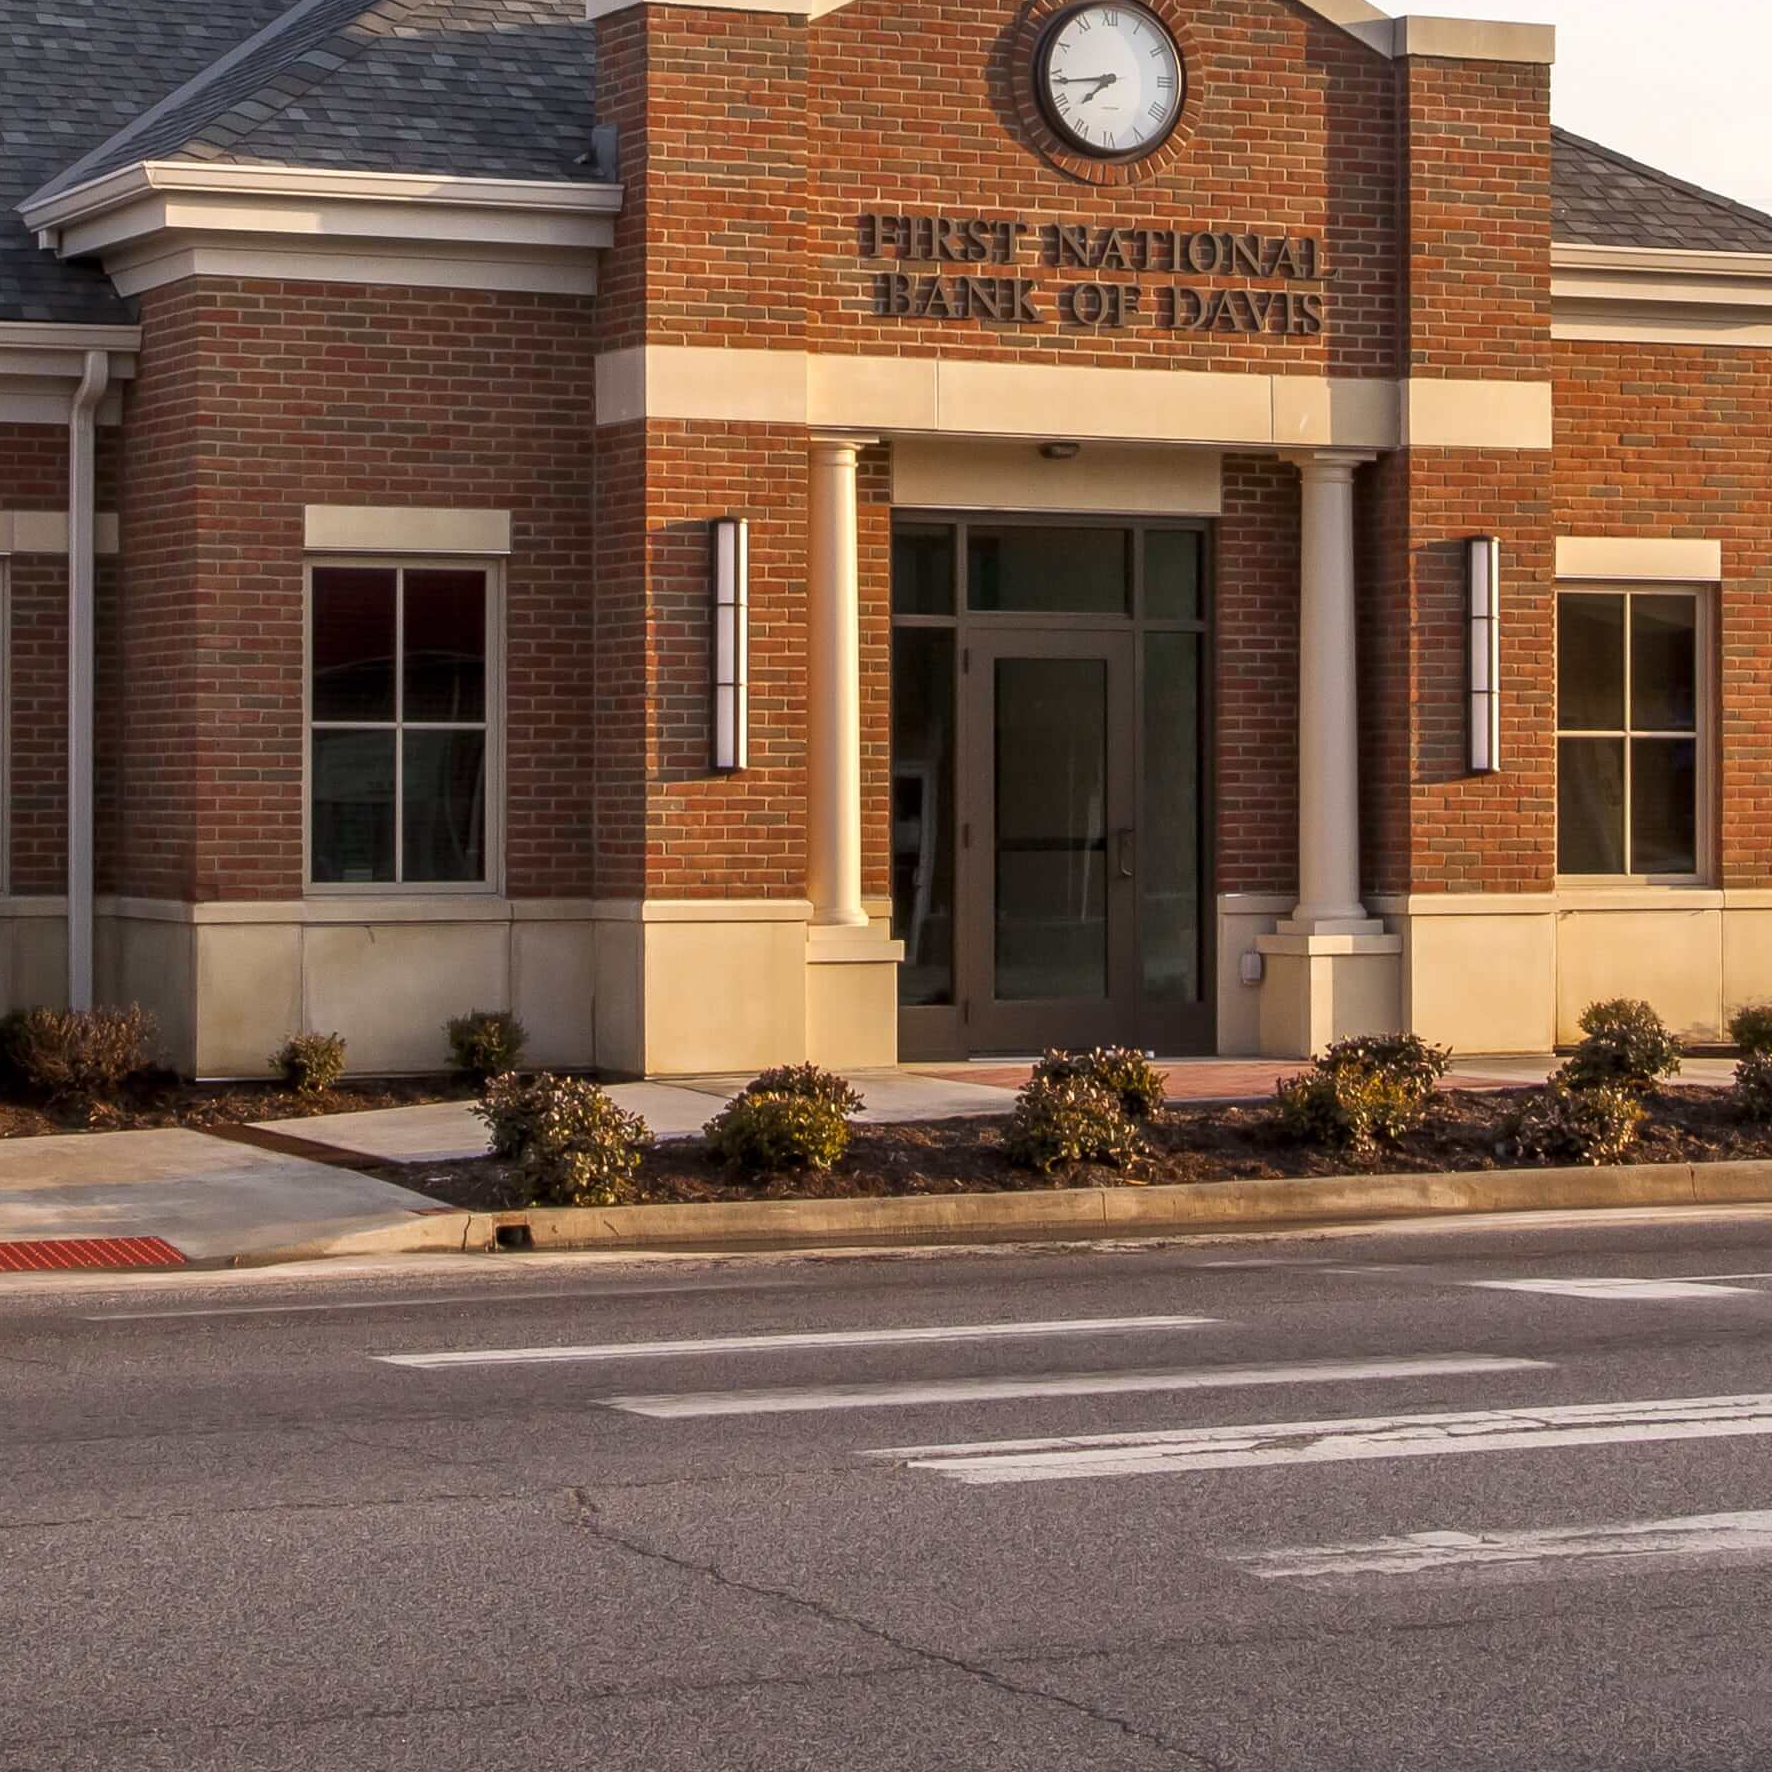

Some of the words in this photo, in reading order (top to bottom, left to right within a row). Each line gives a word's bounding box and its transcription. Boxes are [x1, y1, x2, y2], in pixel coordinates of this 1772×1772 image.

[1101, 9, 1119, 27] XII
[1149, 43, 1165, 58] II
[1156, 76, 1173, 89] III
[868, 213, 1028, 265] FIRST
[1050, 222, 1340, 280] NATIONAL
[885, 273, 1045, 324] BANK
[1072, 283, 1142, 328] OF
[1169, 286, 1325, 335] DAVIS
